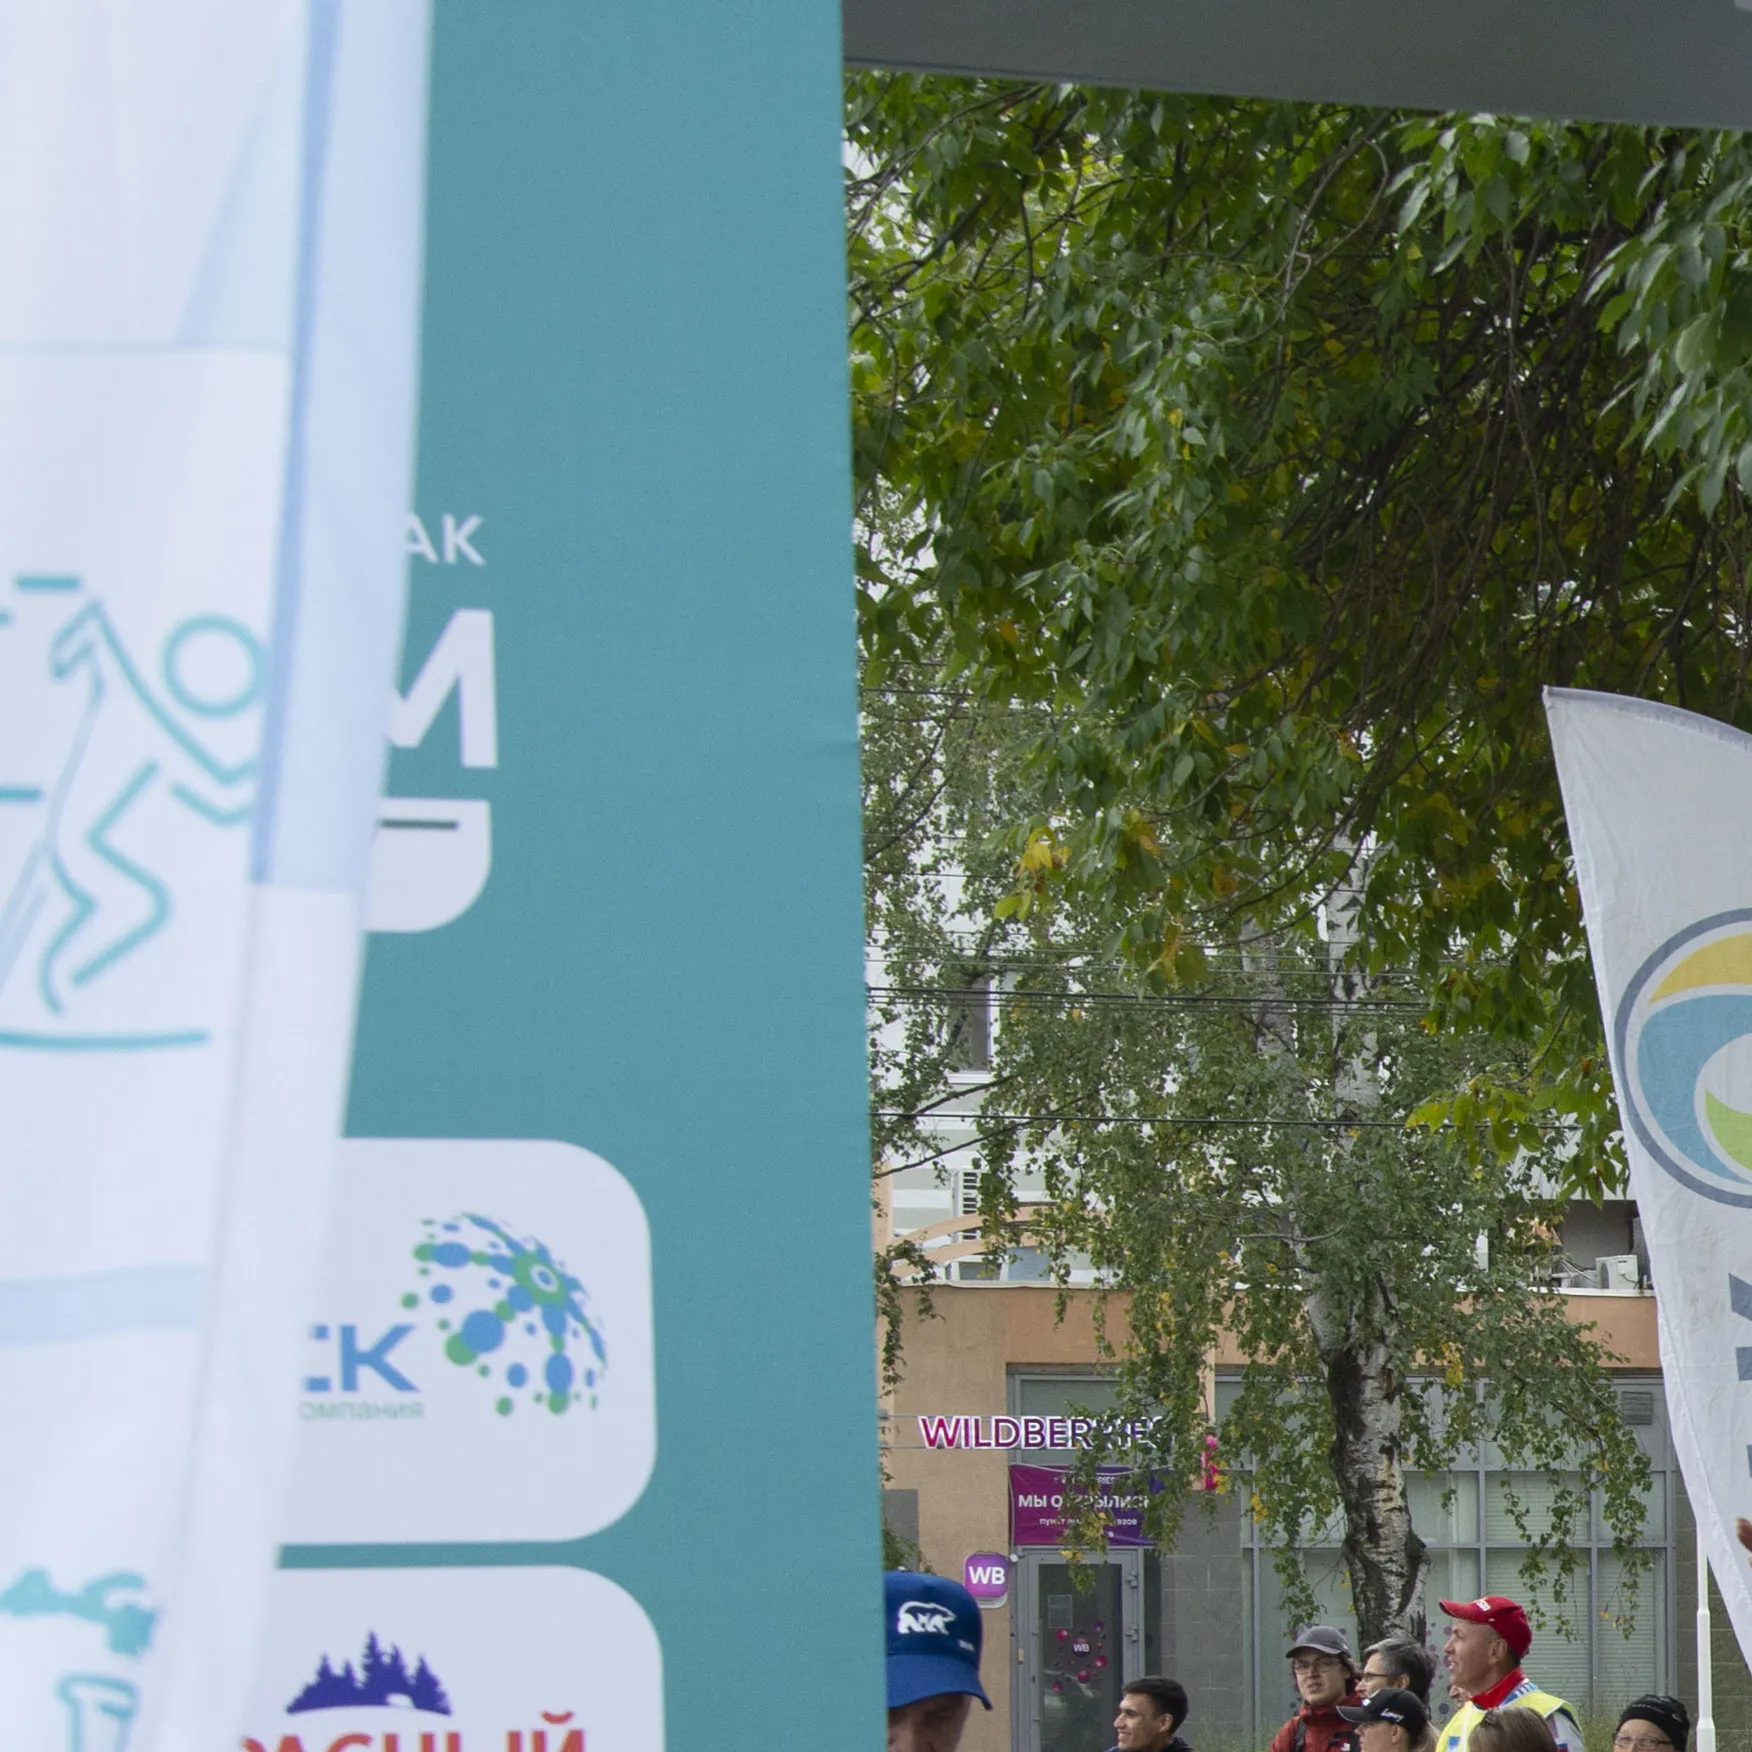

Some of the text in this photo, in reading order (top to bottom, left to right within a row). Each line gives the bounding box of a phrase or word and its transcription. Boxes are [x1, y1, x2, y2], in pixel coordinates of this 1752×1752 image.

[300, 1401, 424, 1421] омпания
[918, 1415, 1175, 1450] WILDBERE
[1018, 1494, 1047, 1509] МЫ
[968, 1566, 1006, 1585] WB
[1073, 1643, 1090, 1653] WB
